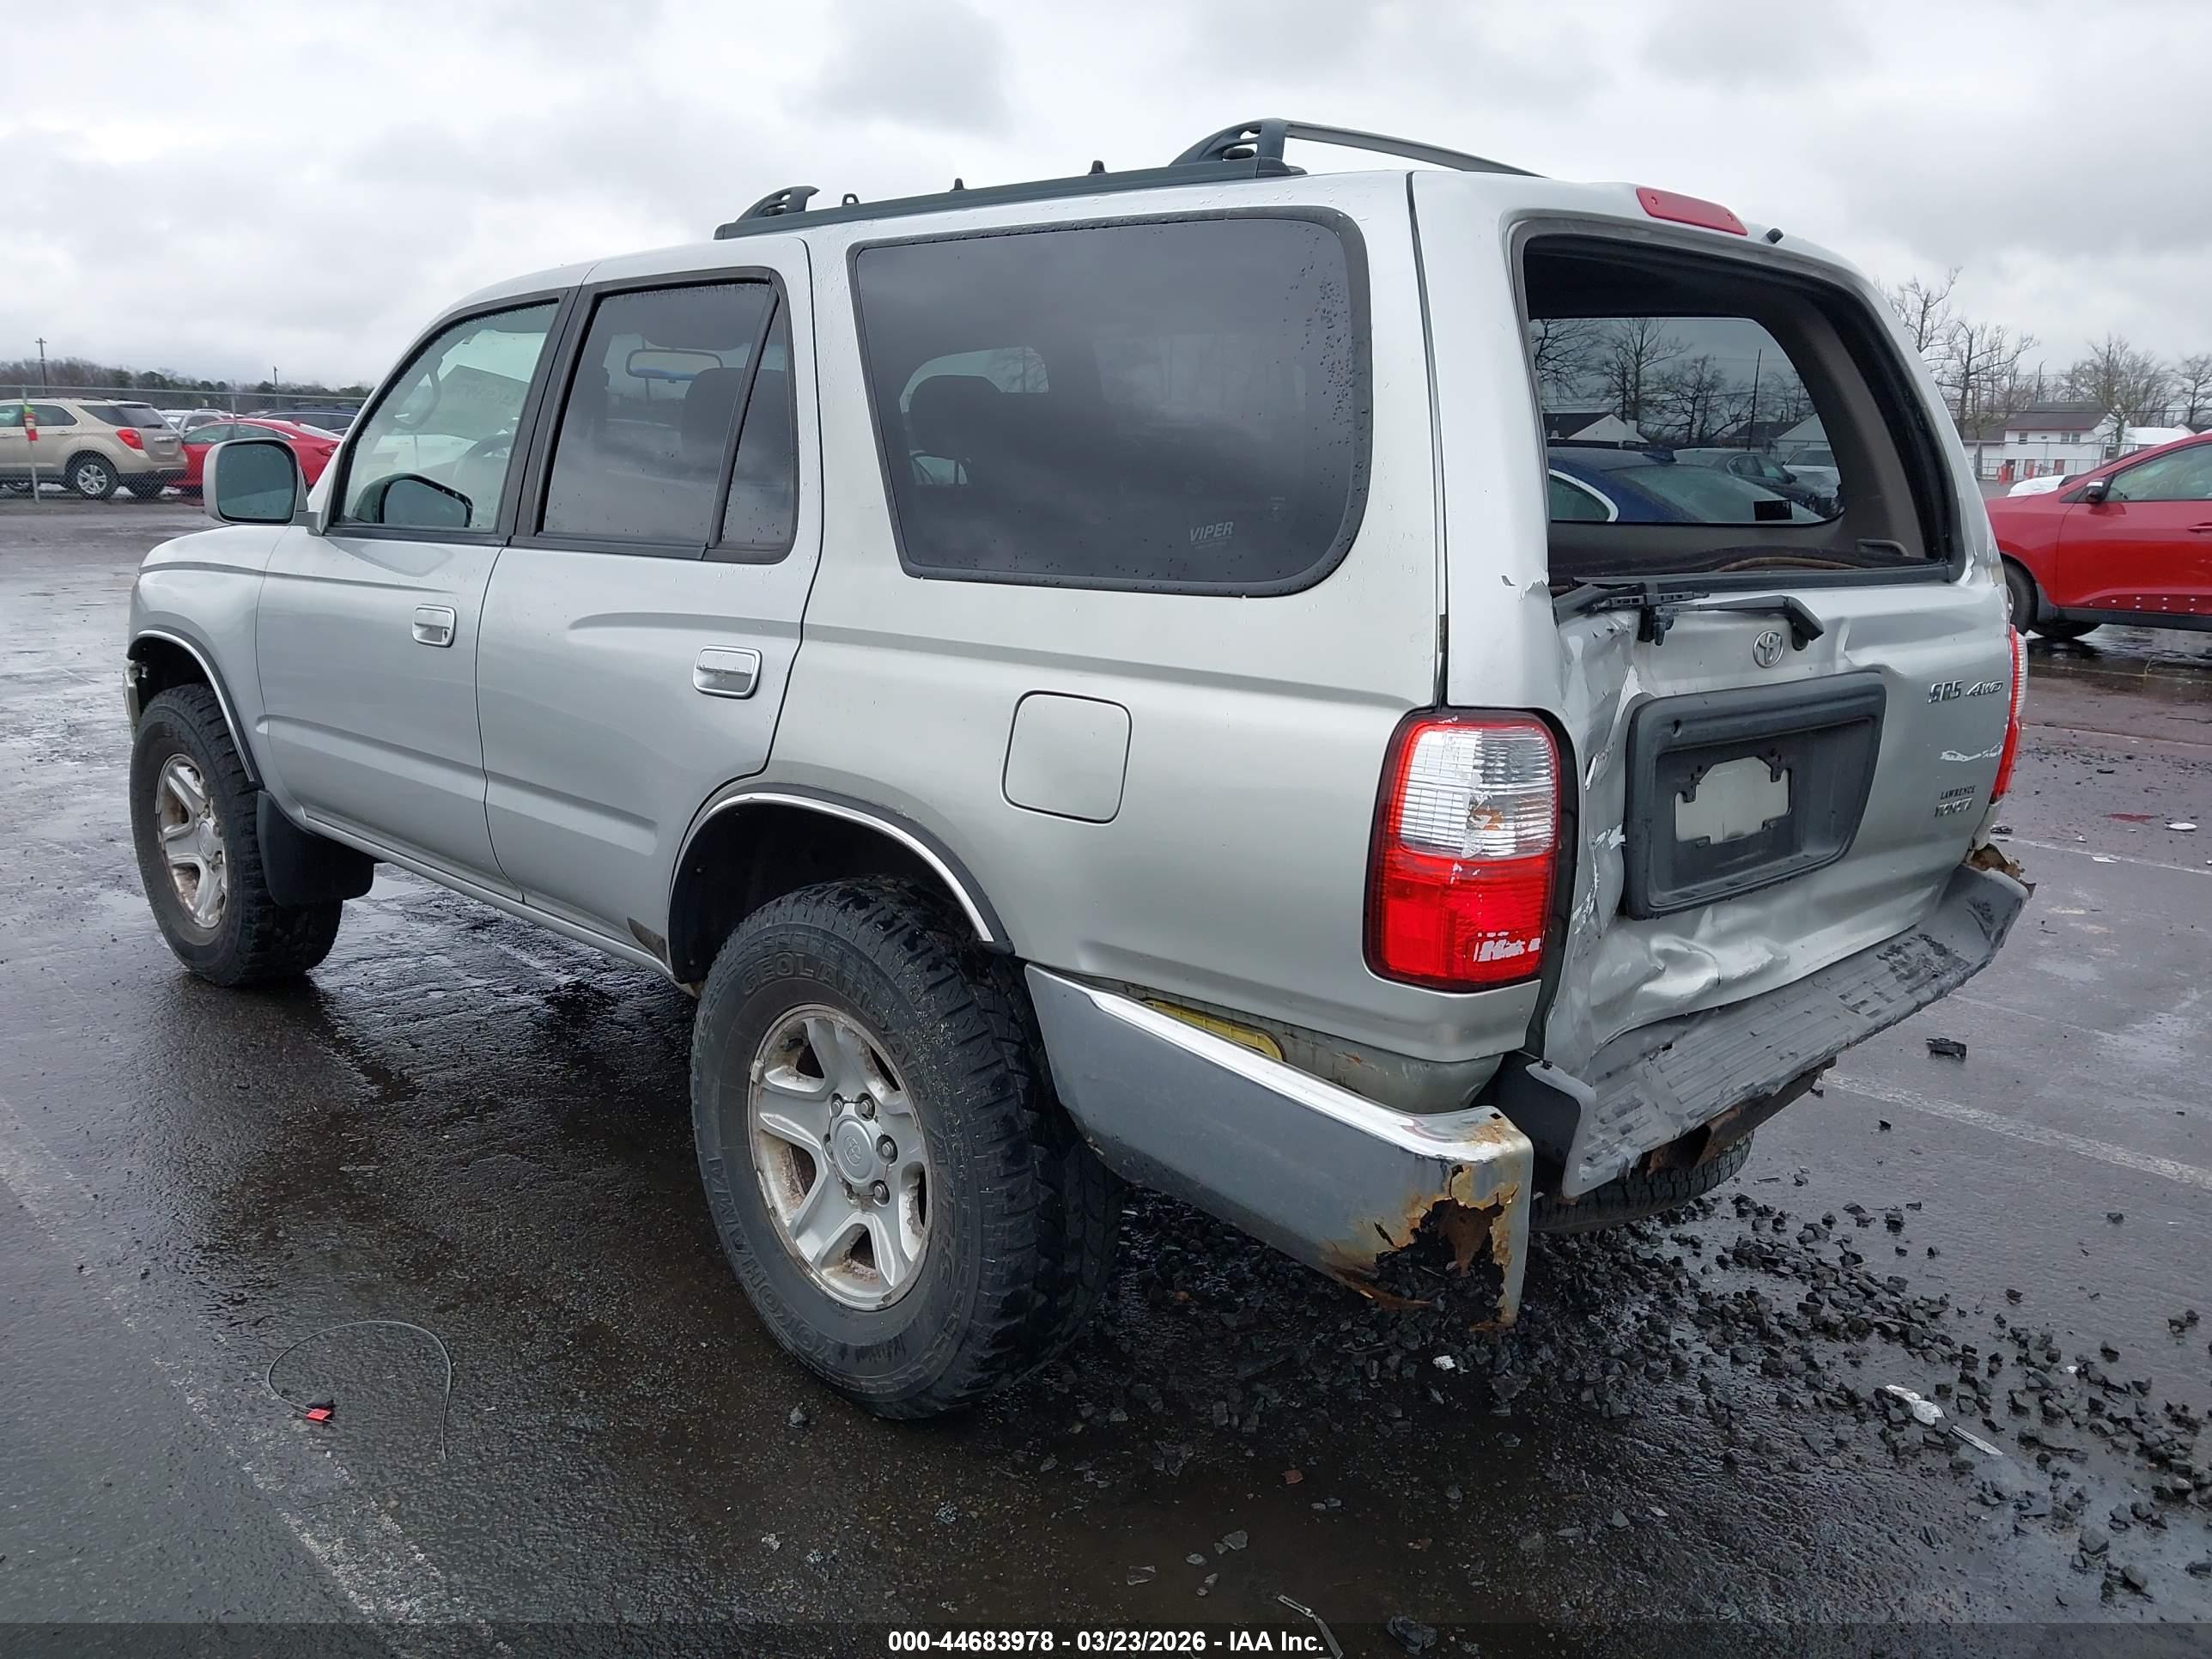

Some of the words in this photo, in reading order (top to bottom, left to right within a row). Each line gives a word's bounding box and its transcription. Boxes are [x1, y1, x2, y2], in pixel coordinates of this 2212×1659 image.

[1189, 521, 1234, 542] VIPER
[1940, 784, 1976, 799] LAWRENCE
[707, 1156, 836, 1366] YOKOHAMA
